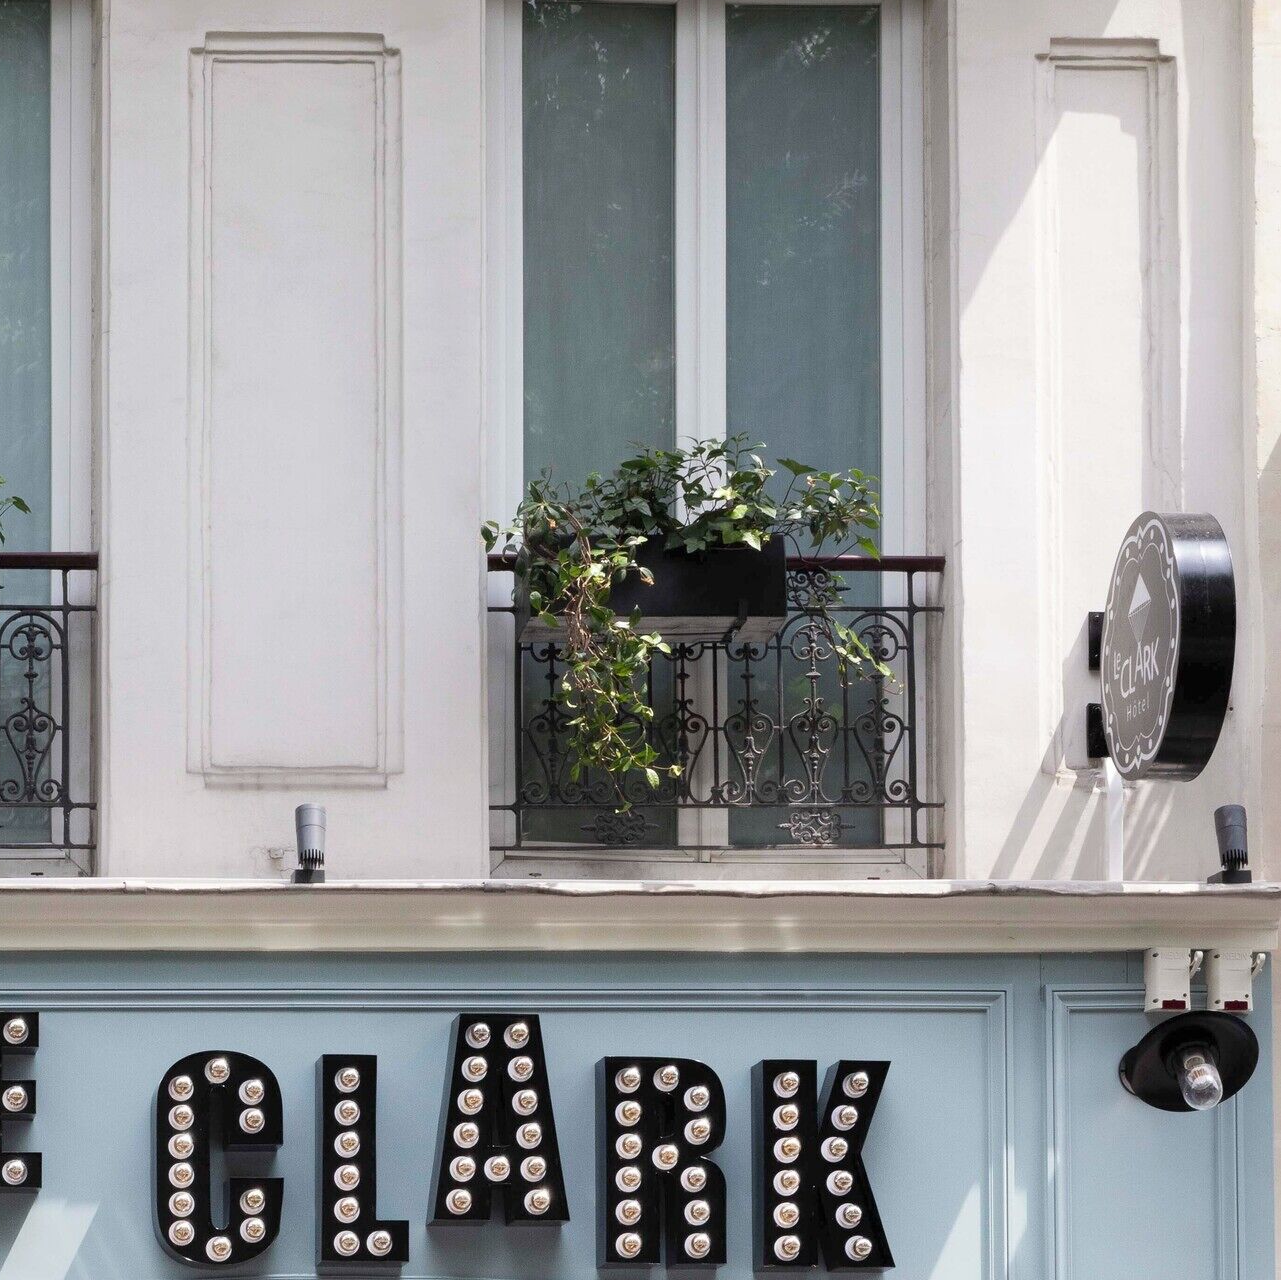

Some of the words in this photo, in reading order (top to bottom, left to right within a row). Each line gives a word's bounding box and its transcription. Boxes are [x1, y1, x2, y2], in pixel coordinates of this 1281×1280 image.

[1120, 636, 1160, 699] CLARK
[1126, 691, 1151, 722] Hôtel
[156, 1013, 895, 1273] CLARK
